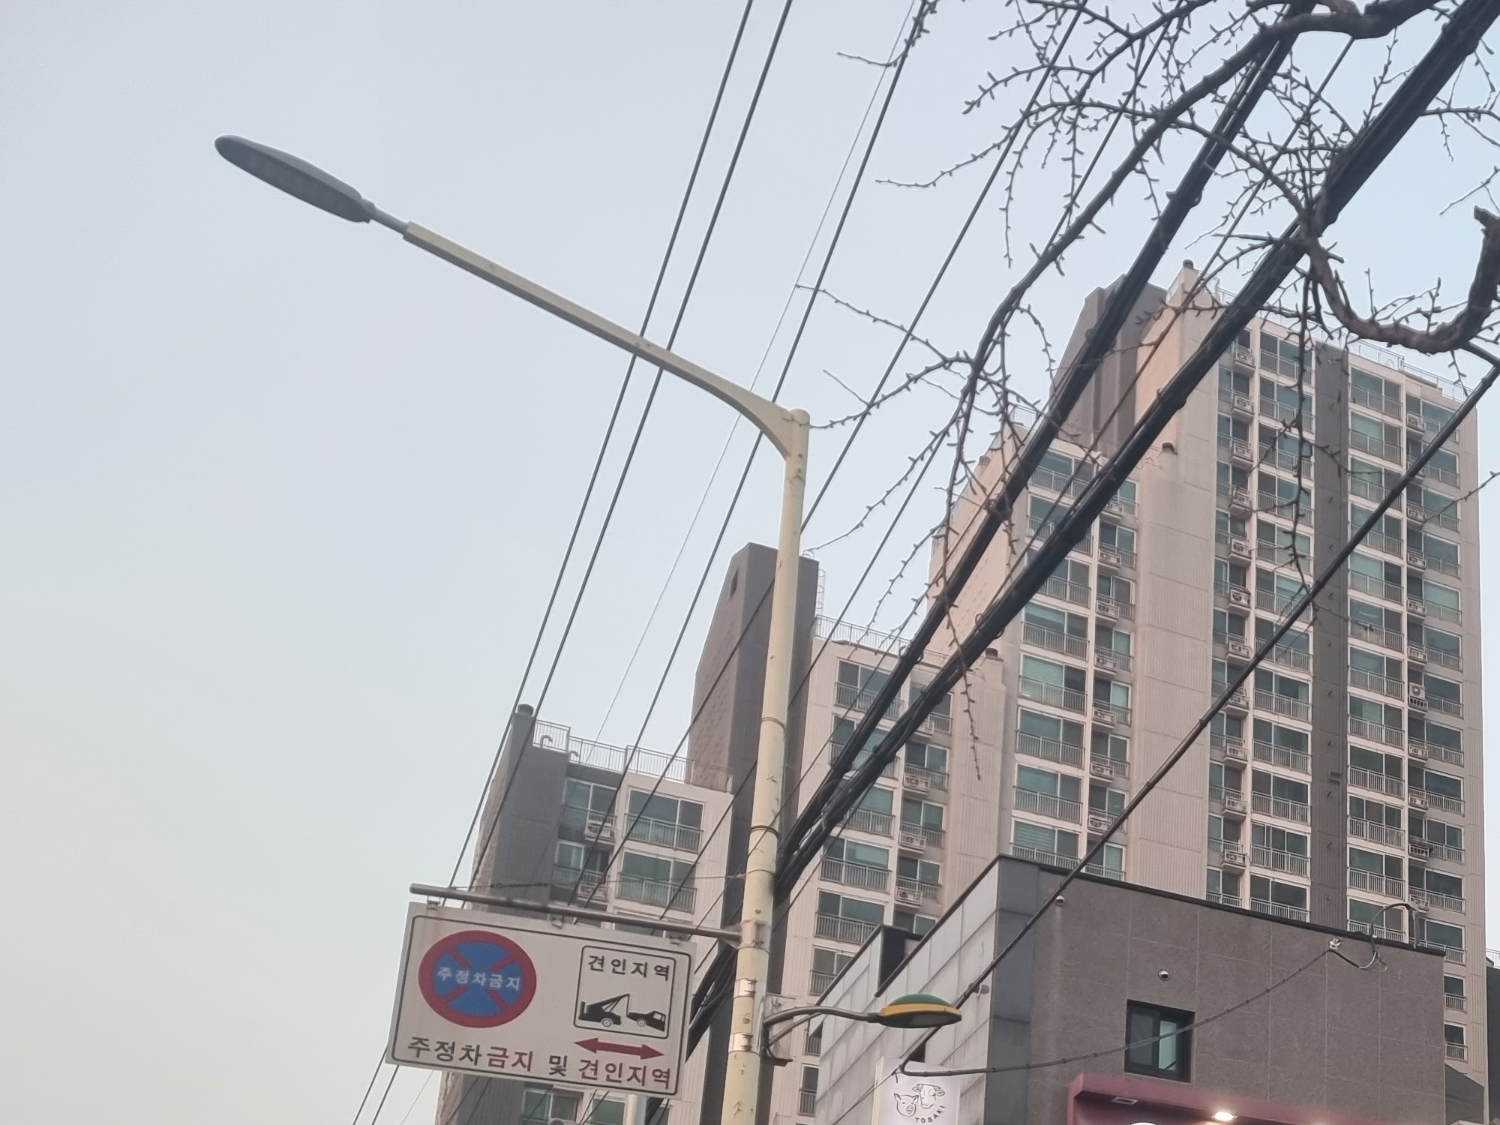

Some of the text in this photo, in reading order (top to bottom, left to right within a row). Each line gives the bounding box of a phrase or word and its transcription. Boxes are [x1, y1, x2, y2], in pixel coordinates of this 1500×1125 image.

[437, 965, 521, 991] 주정차금지
[587, 954, 671, 982] 견인지역
[407, 1036, 672, 1090] 주정차금지 및 견인지역
